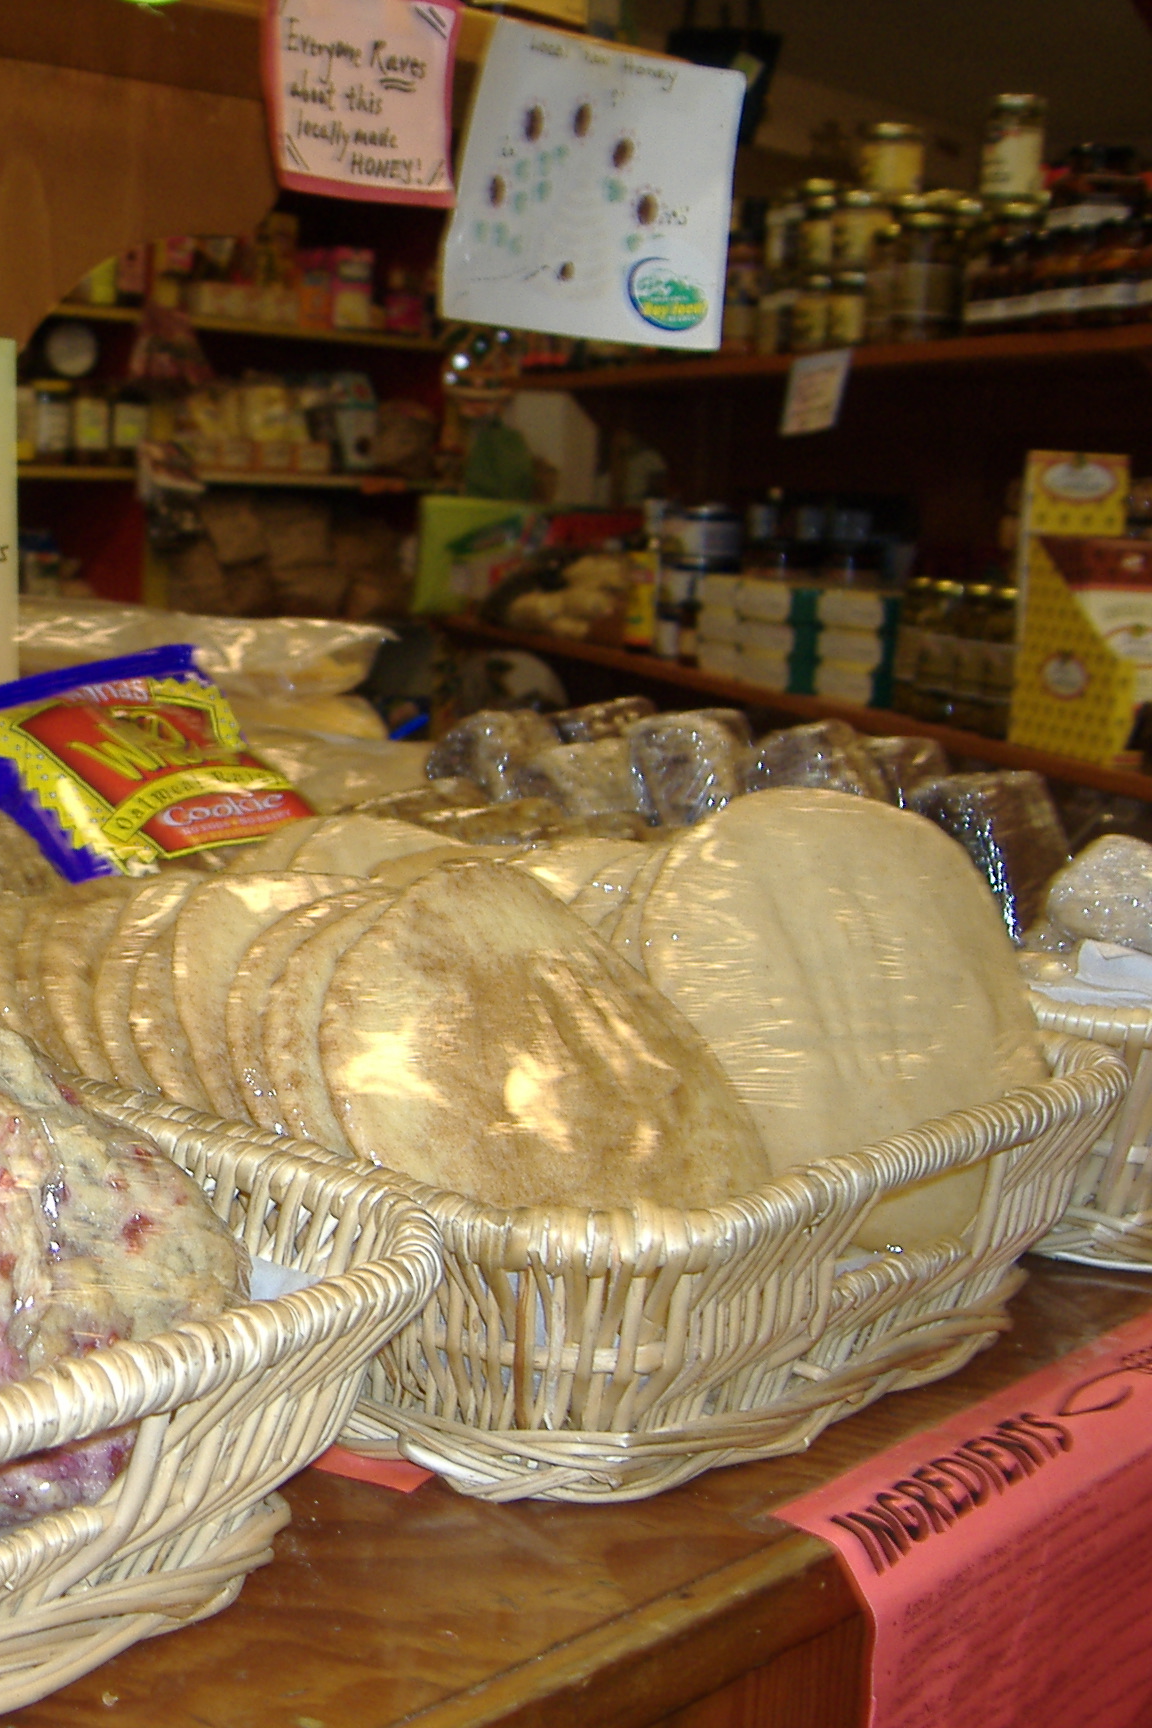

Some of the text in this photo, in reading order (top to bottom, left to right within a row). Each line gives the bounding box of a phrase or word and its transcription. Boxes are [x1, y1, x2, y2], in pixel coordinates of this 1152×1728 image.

[370, 39, 428, 80] Raves
[289, 68, 384, 116] about this
[296, 107, 399, 162] locally made
[160, 792, 285, 828] Cookie
[828, 1411, 1074, 1578] INGREDIENTS
